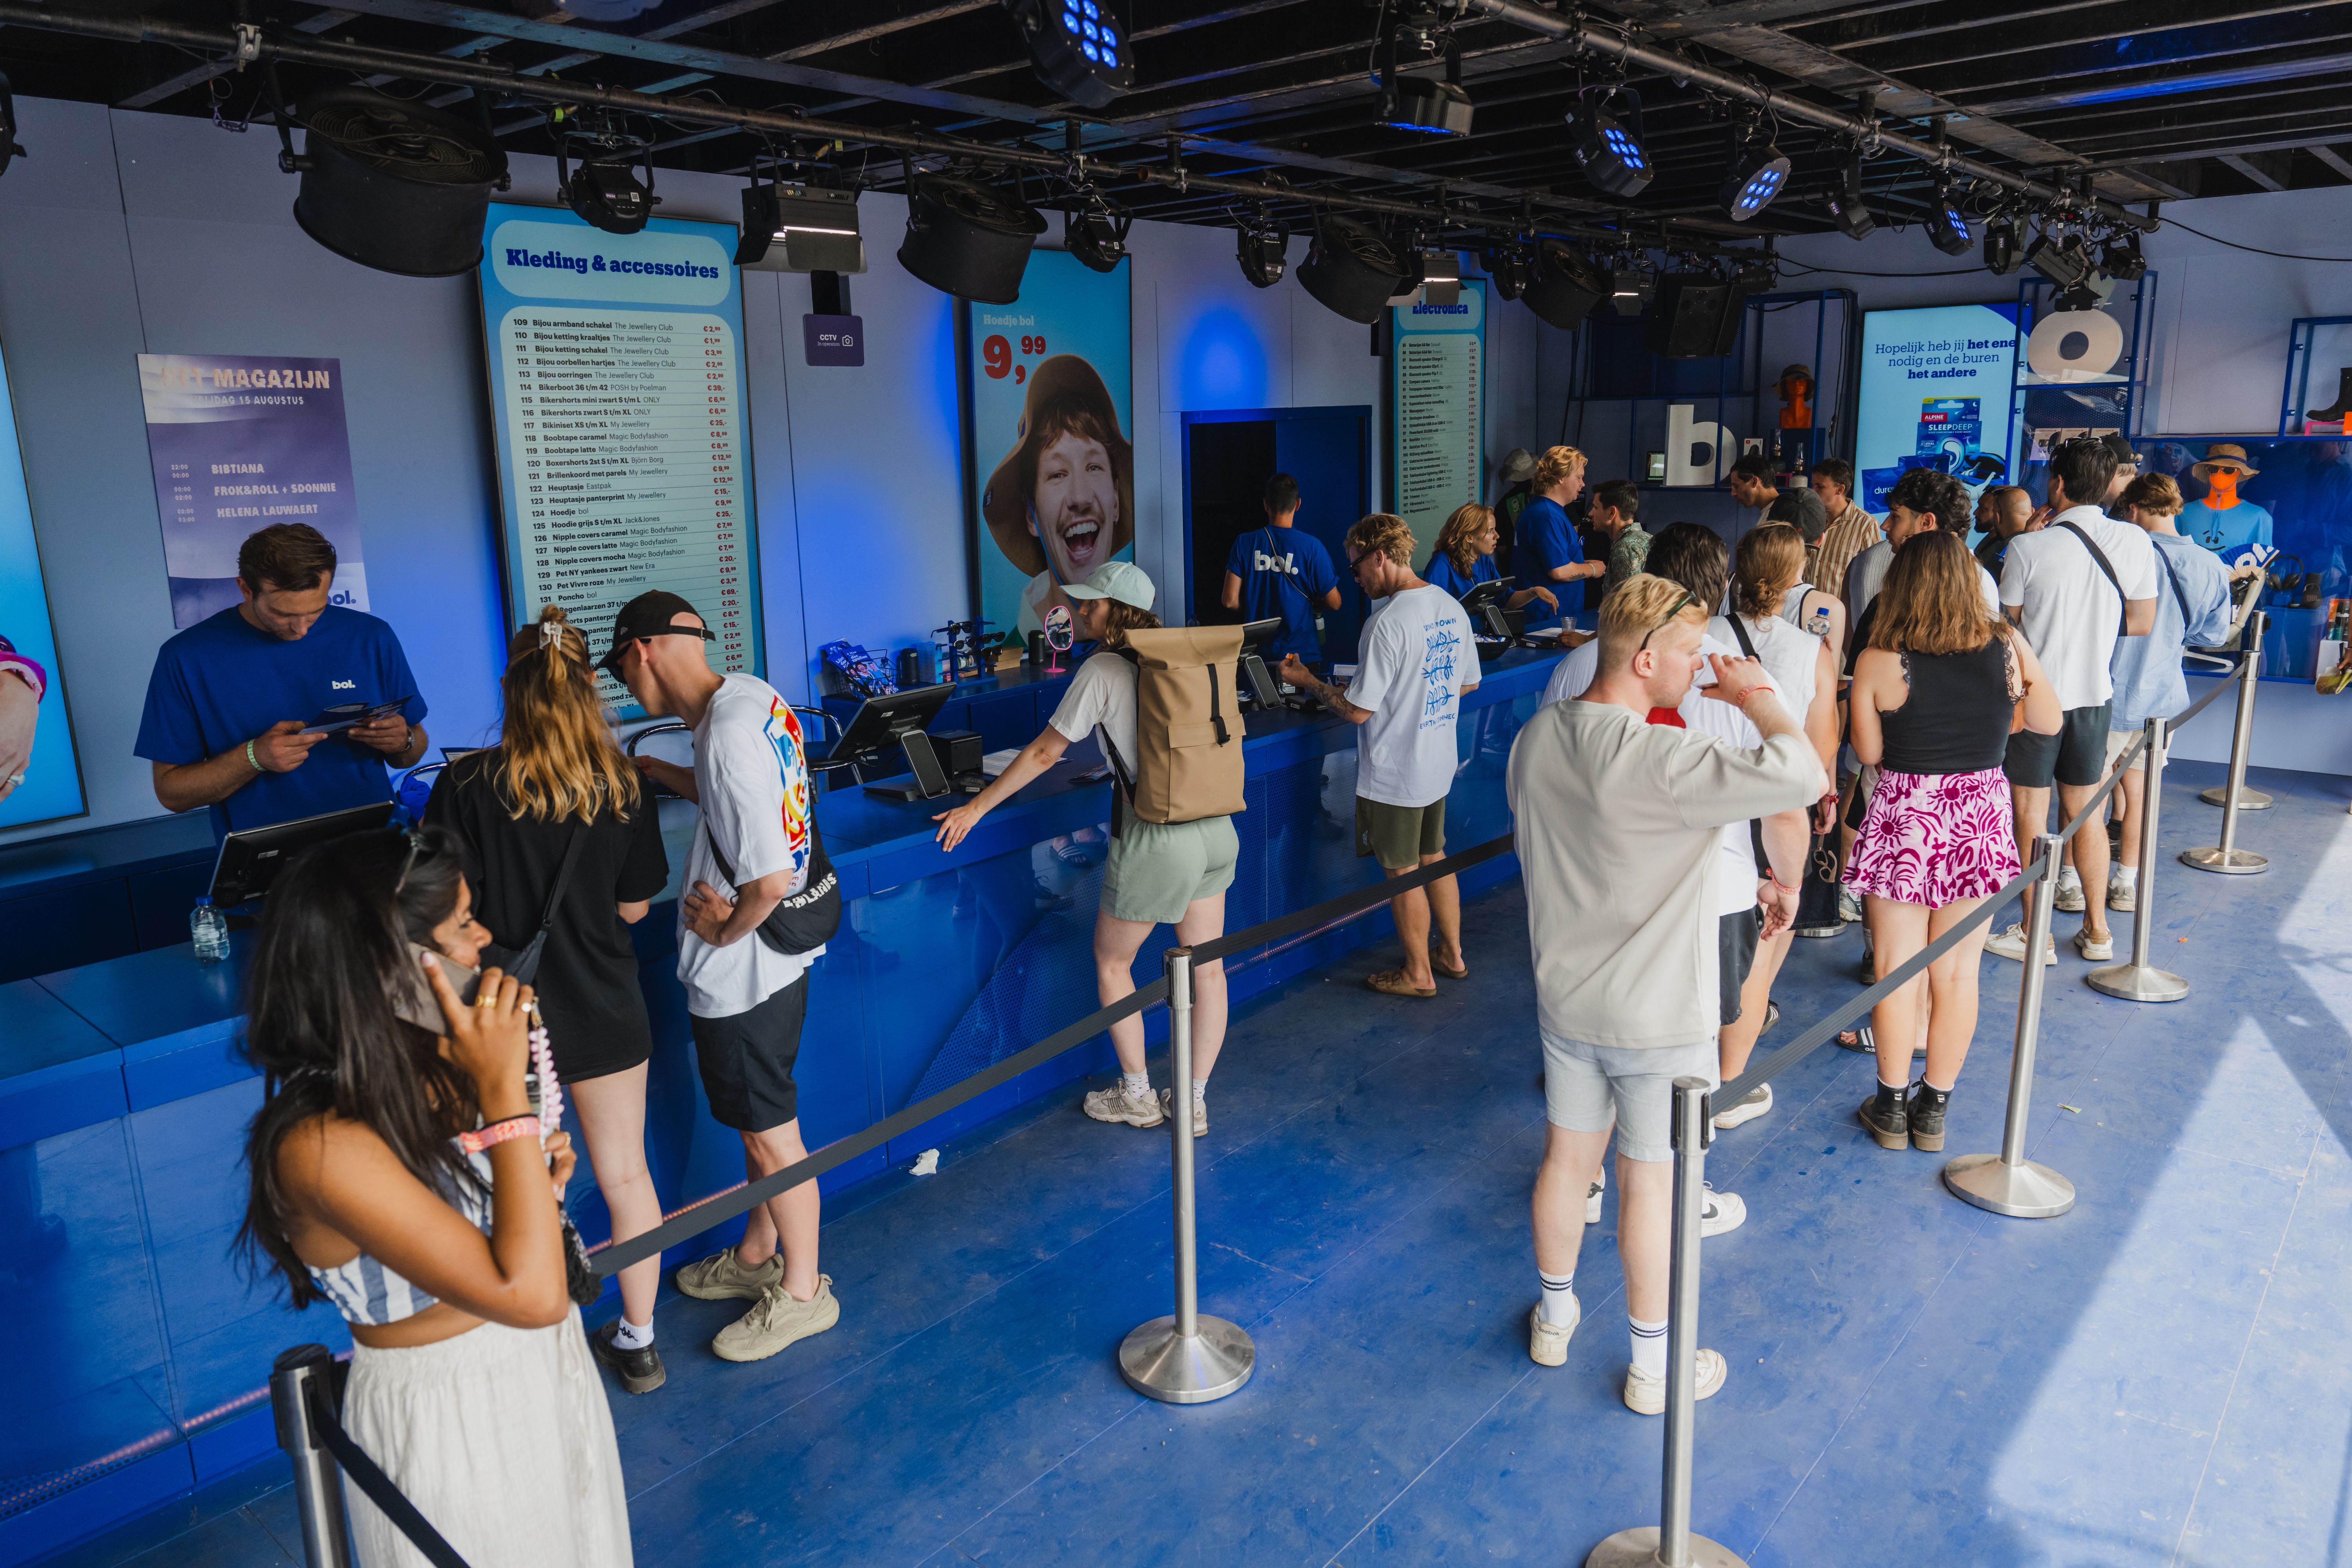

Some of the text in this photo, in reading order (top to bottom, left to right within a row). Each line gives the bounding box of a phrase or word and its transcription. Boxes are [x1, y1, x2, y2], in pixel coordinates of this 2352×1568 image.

[506, 249, 719, 279] Kleding & accessoires
[1413, 300, 1468, 314] Electronica
[532, 319, 552, 328] Bijou
[628, 323, 657, 332] Jewellery
[983, 315, 1034, 327] Hoedje bol
[1875, 339, 2016, 355] Hopelijk heb jij het ene
[983, 334, 1046, 385] 9,99
[1888, 353, 1999, 367] nodig en de buren
[213, 369, 330, 389] MAGAZIJN
[1908, 368, 1977, 379] het andere
[239, 396, 251, 405] 15
[254, 396, 304, 405] AUGUSTUS
[211, 464, 265, 474] BIBTIANA
[214, 485, 278, 496] FROK&ROLL
[291, 483, 336, 493] SDONNIE
[549, 496, 585, 504] Heuptasje
[586, 494, 625, 503] panterprint
[217, 507, 260, 518] HELENA
[263, 504, 317, 516] LAUWAERT
[552, 533, 576, 541] Nipple
[601, 529, 628, 537] caramel
[651, 525, 687, 534] Bodyfashion
[1255, 550, 1298, 575] bol.
[580, 567, 608, 576] yankees
[558, 593, 584, 601] Poncho
[559, 603, 606, 614] Regenlaarzen
[332, 680, 356, 689] bol.
[1420, 719, 1436, 729] EARTH
[1538, 1326, 1559, 1336] Reebok
[1628, 1370, 1645, 1382] eebok
